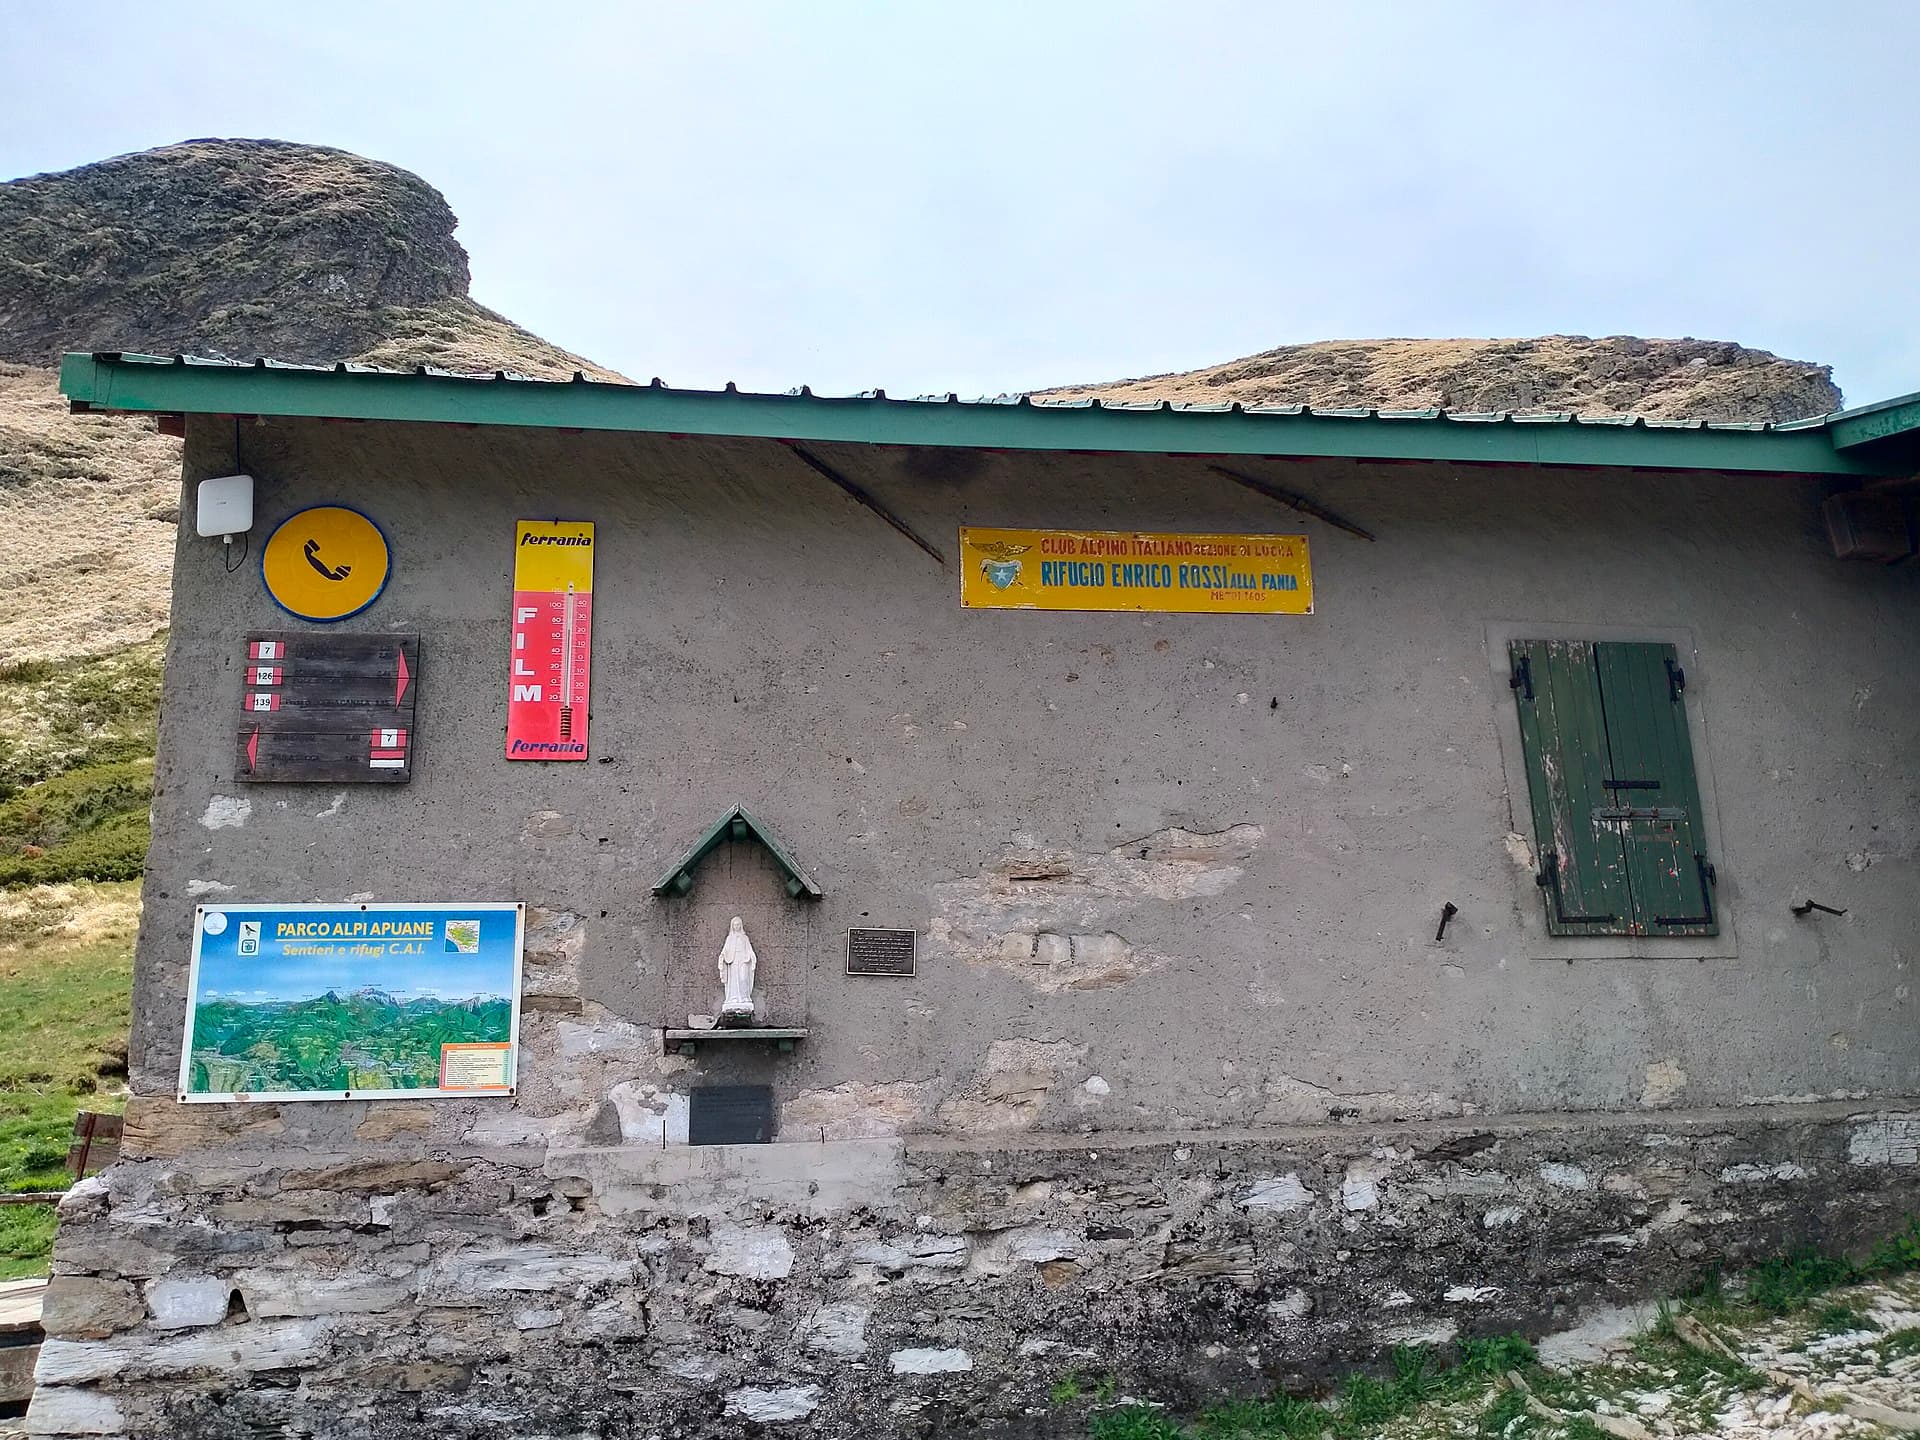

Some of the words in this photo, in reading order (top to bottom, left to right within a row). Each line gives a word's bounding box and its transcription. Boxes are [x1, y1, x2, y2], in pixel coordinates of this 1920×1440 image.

[520, 532, 592, 547] ferrania
[1041, 539, 1077, 555] CLUB
[1080, 540, 1128, 556] ALPINO
[1132, 540, 1192, 556] ITALIANO
[1041, 561, 1105, 587] RIFUGIO
[1230, 573, 1257, 590] ALLA
[1262, 573, 1298, 591] PANIA
[264, 646, 271, 654] 7
[257, 672, 273, 681] 126
[255, 698, 271, 706] 139
[387, 734, 393, 742] 7
[511, 738, 584, 754] ferrania
[277, 922, 330, 937] PARCO
[332, 922, 367, 936] ALPI
[369, 922, 434, 936] APUANE
[282, 944, 335, 956] Sentieri
[338, 945, 346, 956] e
[350, 943, 385, 958] rifugi
[389, 943, 425, 955] C.A.I.
